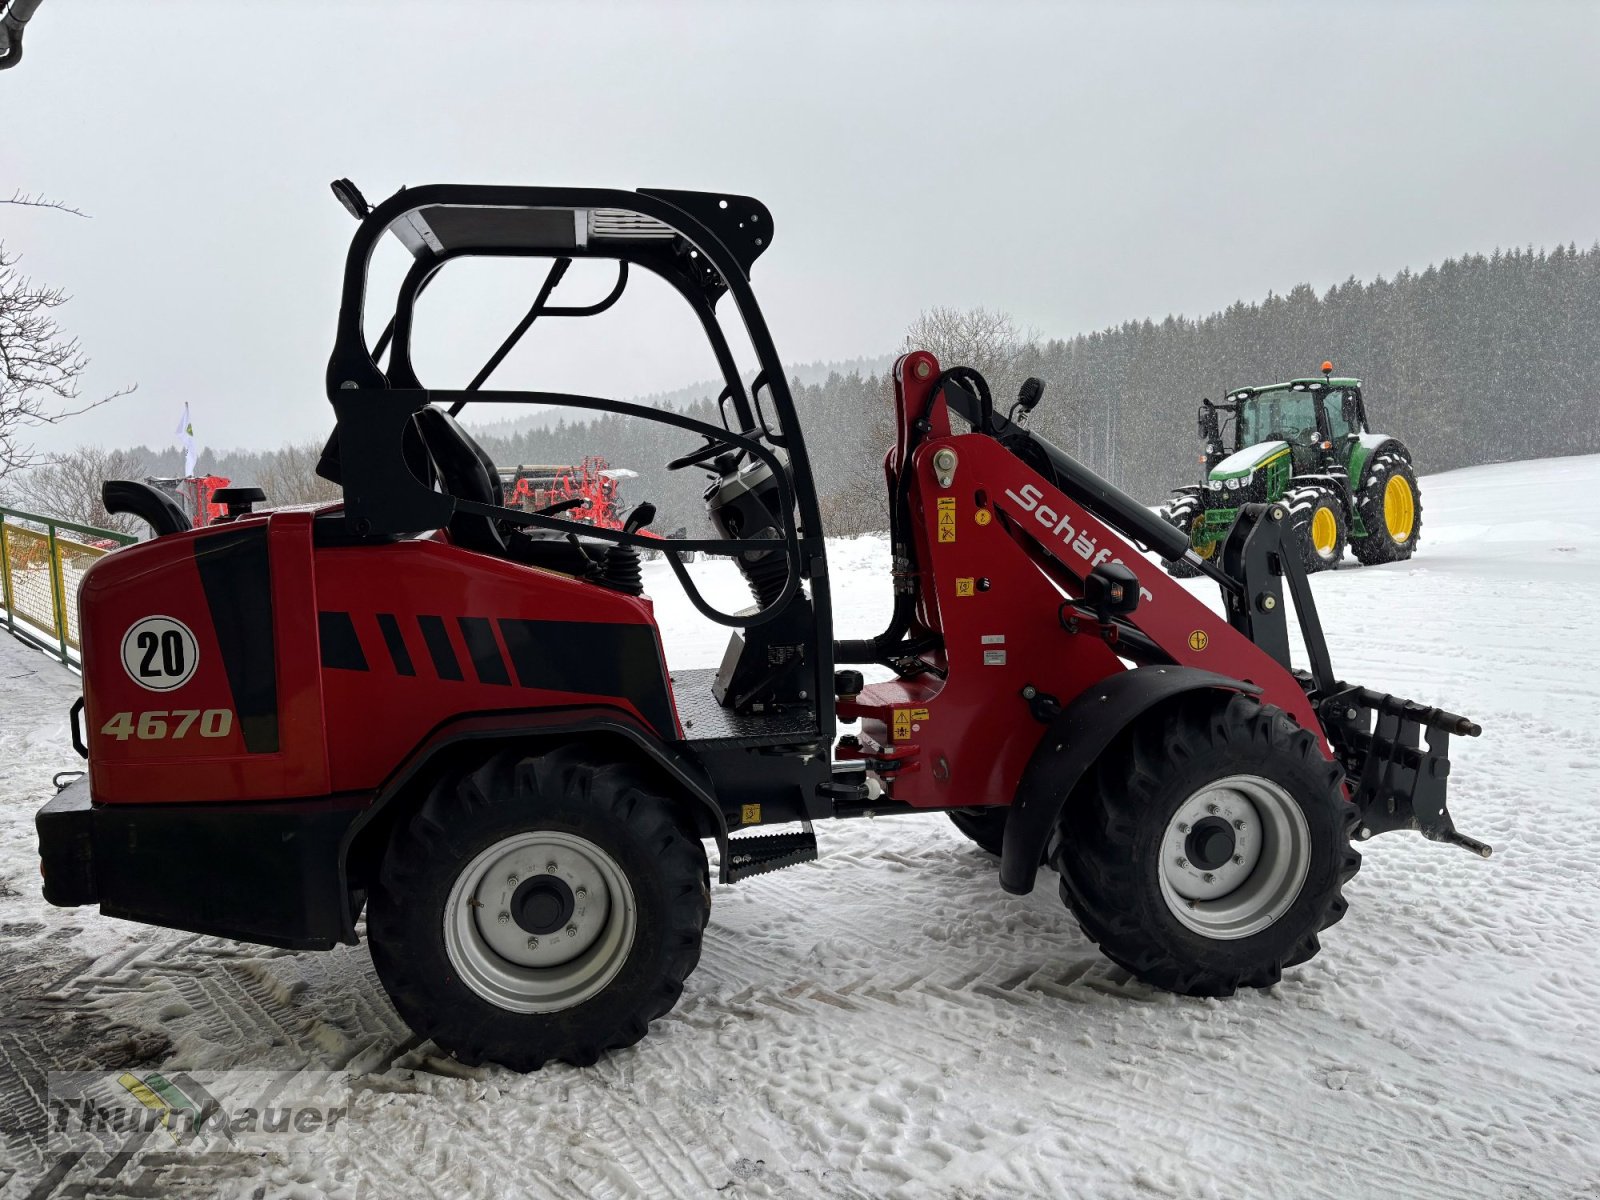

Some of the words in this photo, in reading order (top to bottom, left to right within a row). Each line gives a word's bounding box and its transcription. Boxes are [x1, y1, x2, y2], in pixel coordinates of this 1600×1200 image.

[1004, 483, 1153, 602] Schäfr
[137, 630, 185, 677] 20
[100, 708, 233, 741] 4670
